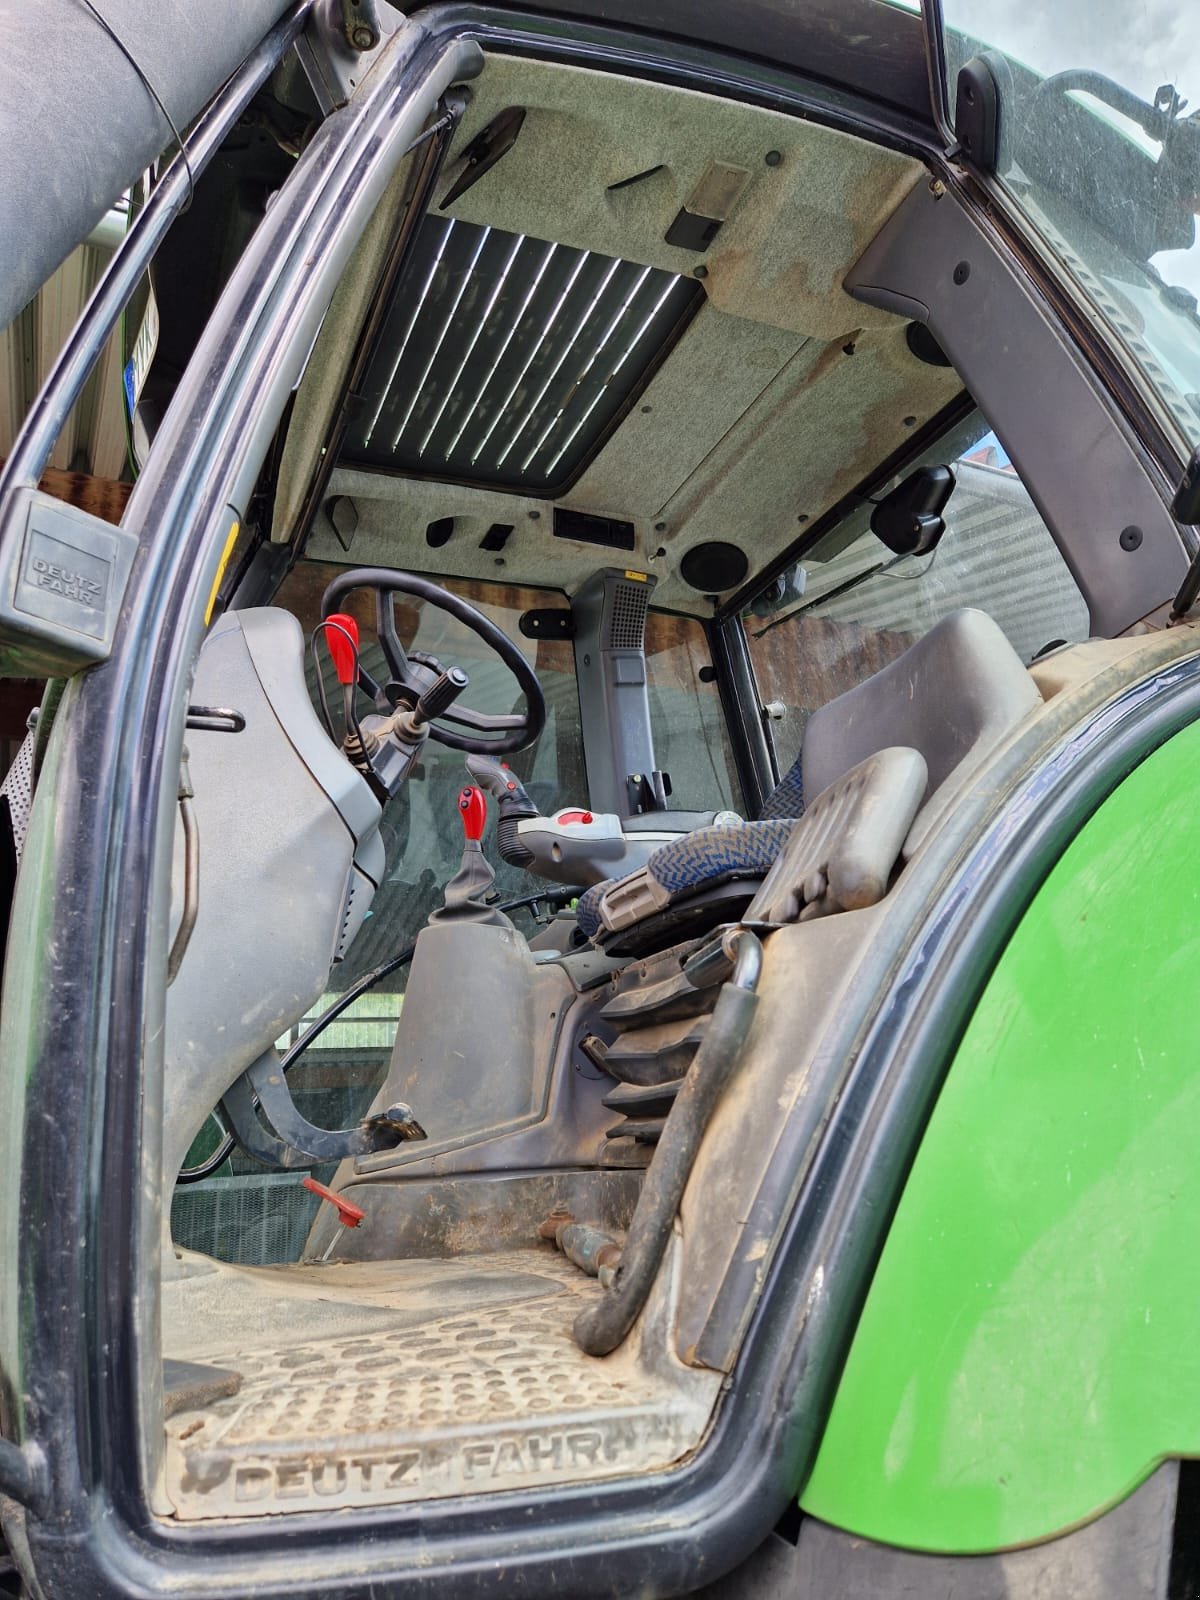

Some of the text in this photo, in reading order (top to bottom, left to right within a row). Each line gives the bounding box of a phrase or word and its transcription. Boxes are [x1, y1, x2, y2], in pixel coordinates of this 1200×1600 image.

[33, 559, 102, 595] DEUTZ
[38, 575, 94, 605] FAHR
[235, 1429, 603, 1502] DEUTZ FAHR
